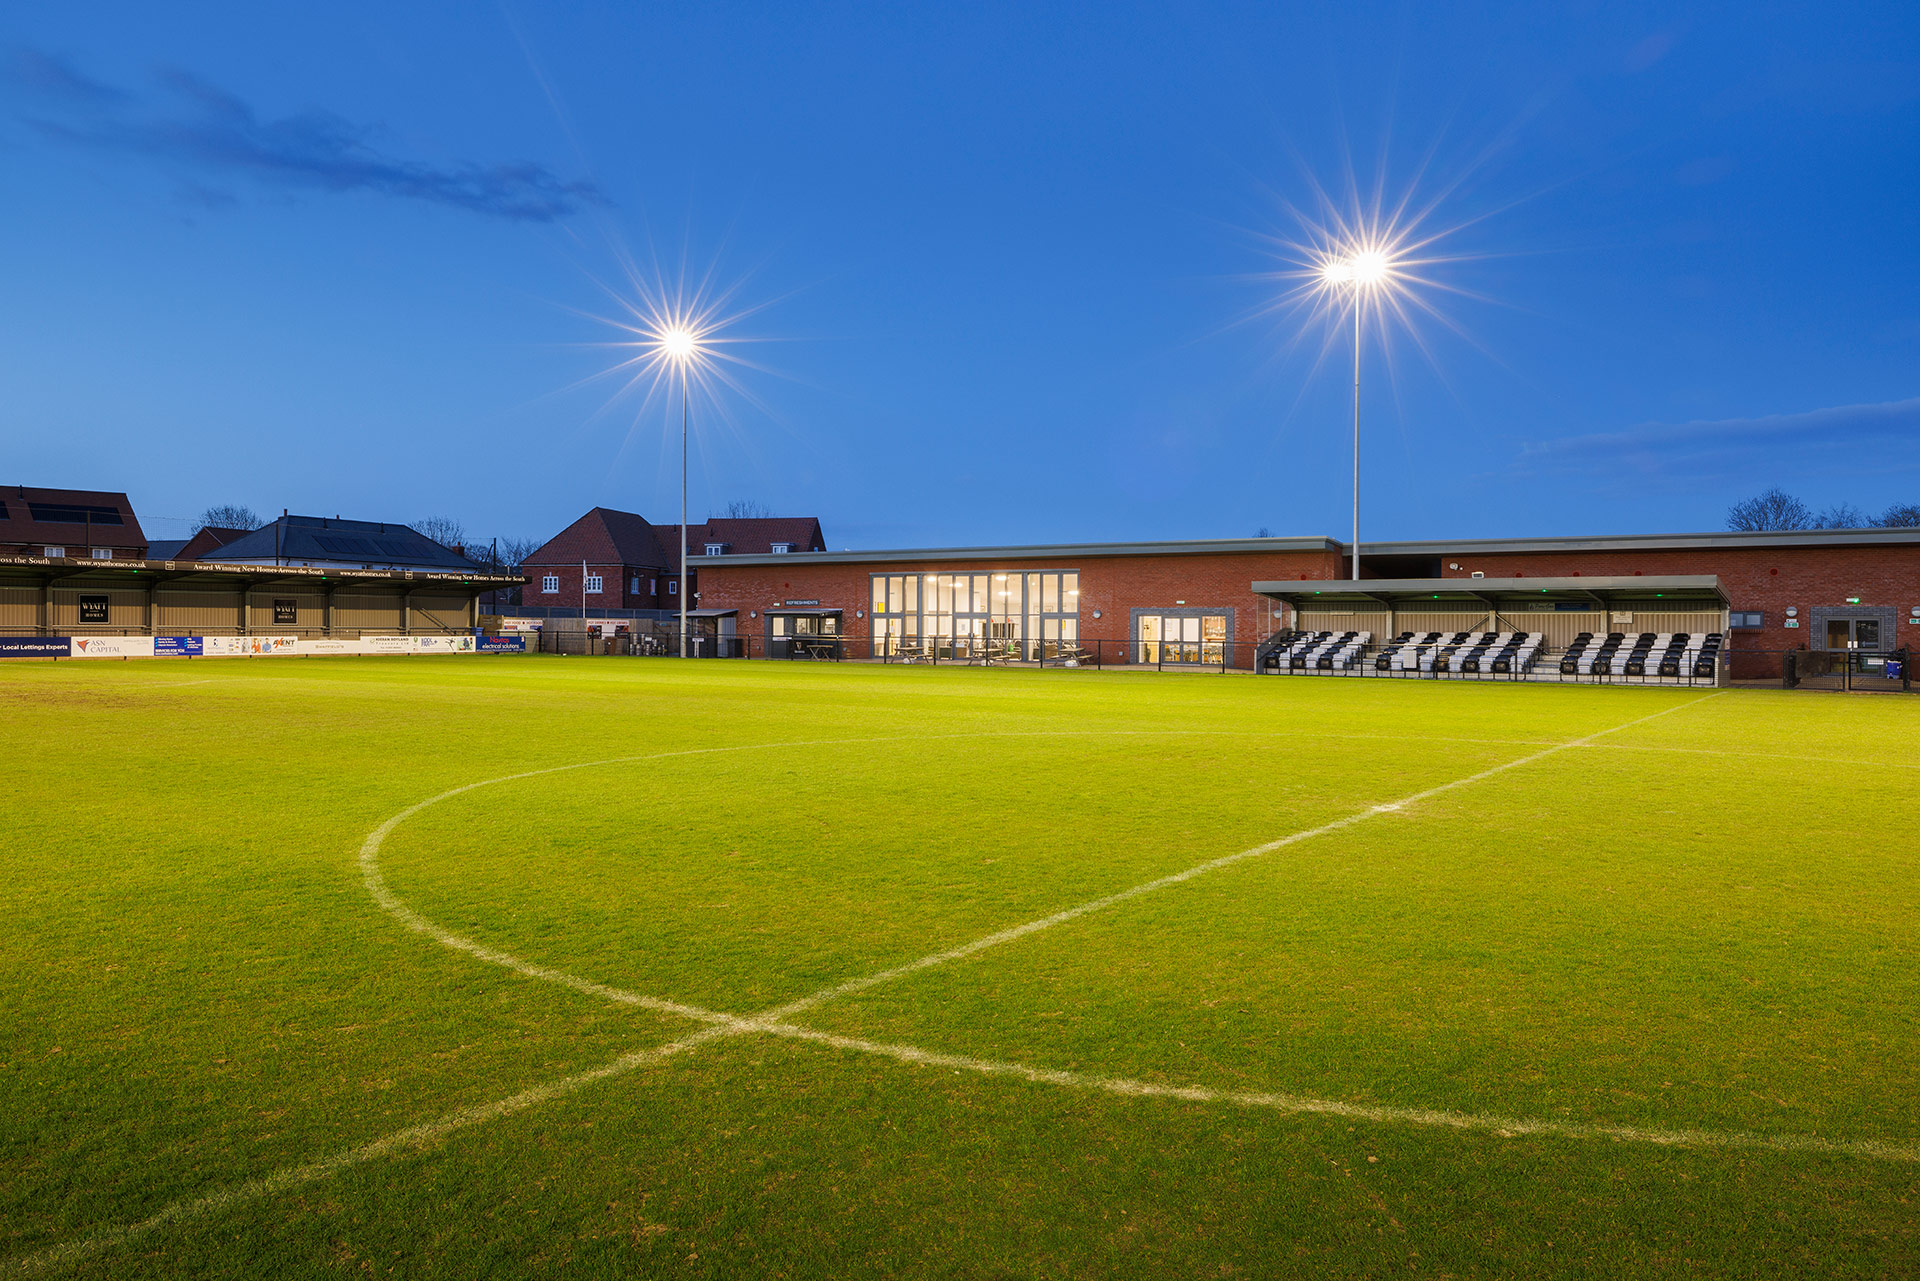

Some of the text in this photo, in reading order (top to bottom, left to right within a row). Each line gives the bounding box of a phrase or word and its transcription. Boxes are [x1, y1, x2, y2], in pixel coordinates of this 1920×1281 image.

[28, 557, 50, 565] South
[76, 560, 147, 569] www.wyatthomes.co.uk
[82, 602, 107, 610] WYATT
